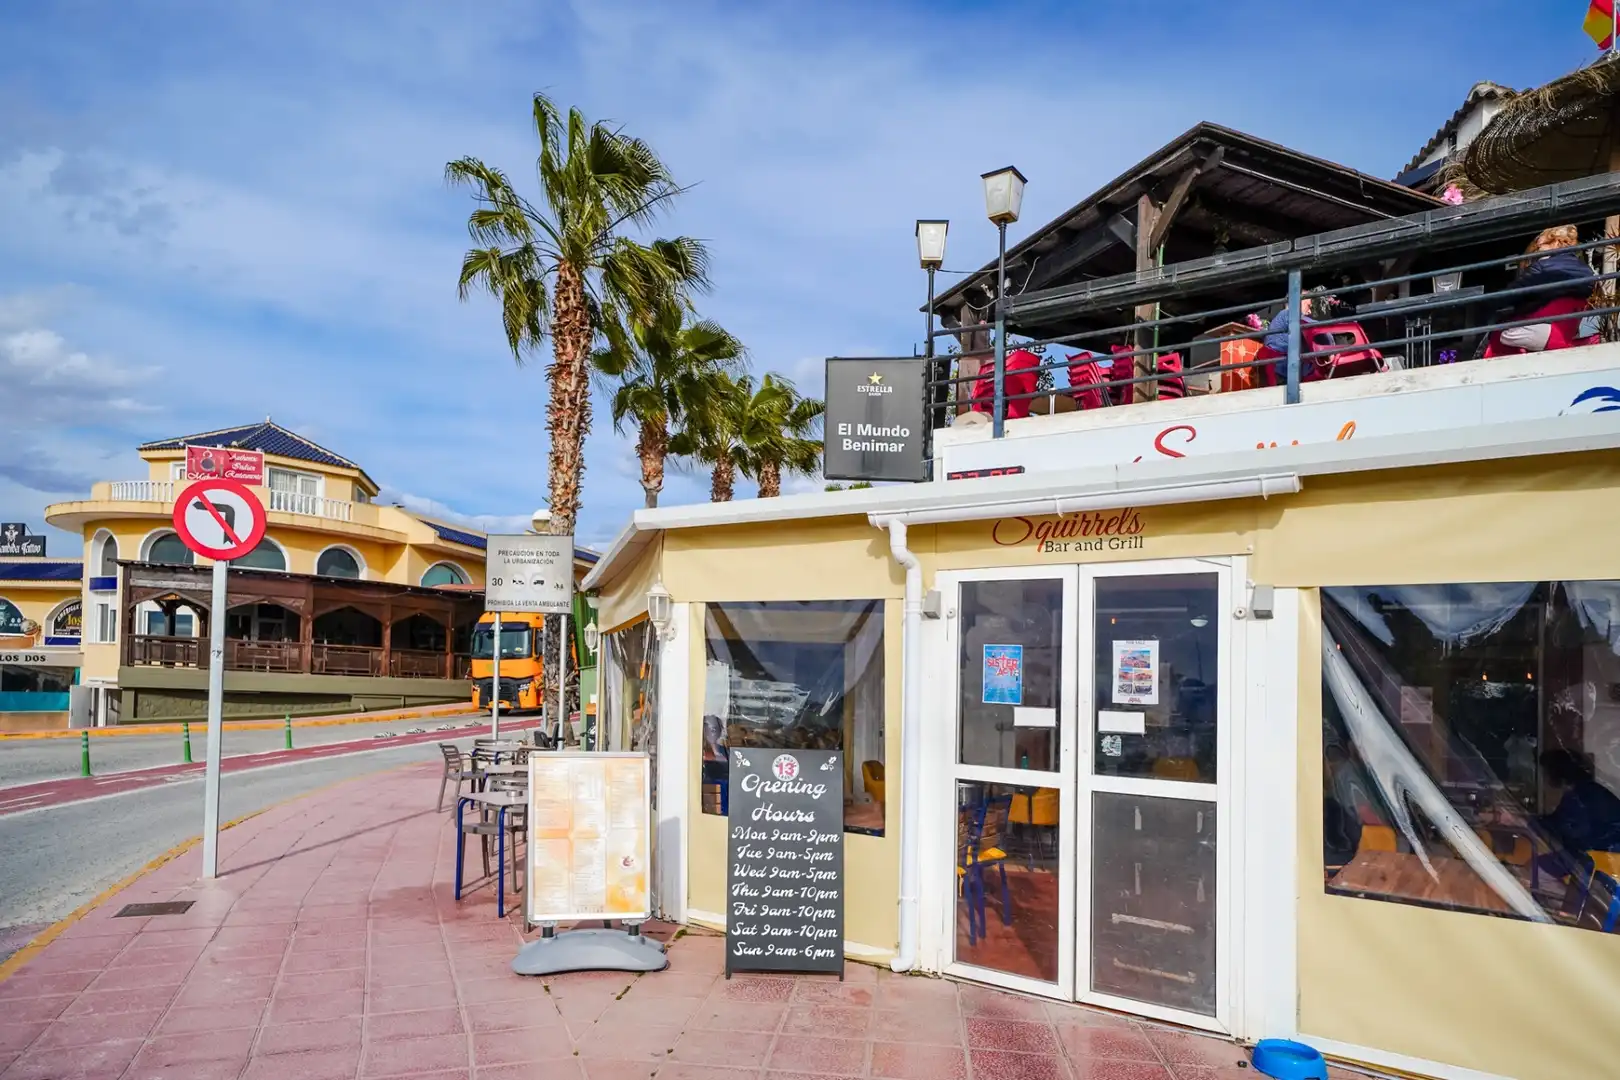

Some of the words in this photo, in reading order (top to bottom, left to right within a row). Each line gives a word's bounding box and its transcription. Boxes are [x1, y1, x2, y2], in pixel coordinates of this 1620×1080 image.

[857, 384, 893, 394] ESTRELLA
[838, 423, 852, 436] El
[857, 423, 910, 437] Mundo
[842, 438, 906, 453] Benimar
[1045, 541, 1070, 553] Bar
[1075, 538, 1103, 552] and
[1108, 536, 1144, 550] Grill
[491, 577, 503, 587] 30
[24, 654, 46, 662] DOS
[986, 656, 1018, 670] SISTER
[996, 666, 1014, 677] ACT
[776, 761, 796, 776] 13
[741, 773, 828, 799] Opening
[751, 802, 816, 823] Hours
[731, 826, 767, 841] Mon
[736, 845, 763, 860] Tue
[766, 847, 835, 864] 9am-5pm
[733, 863, 767, 878] Wed
[769, 866, 838, 881] 9am-5pm
[731, 881, 760, 898] Thu
[761, 885, 839, 902] 9am-10pm
[733, 902, 757, 917] Fri
[760, 905, 836, 922] 9am-10pm
[731, 922, 758, 936] Sat
[761, 924, 838, 941] 9am-10pm
[733, 942, 764, 956] Sun
[764, 944, 836, 960] 9am-6pm
